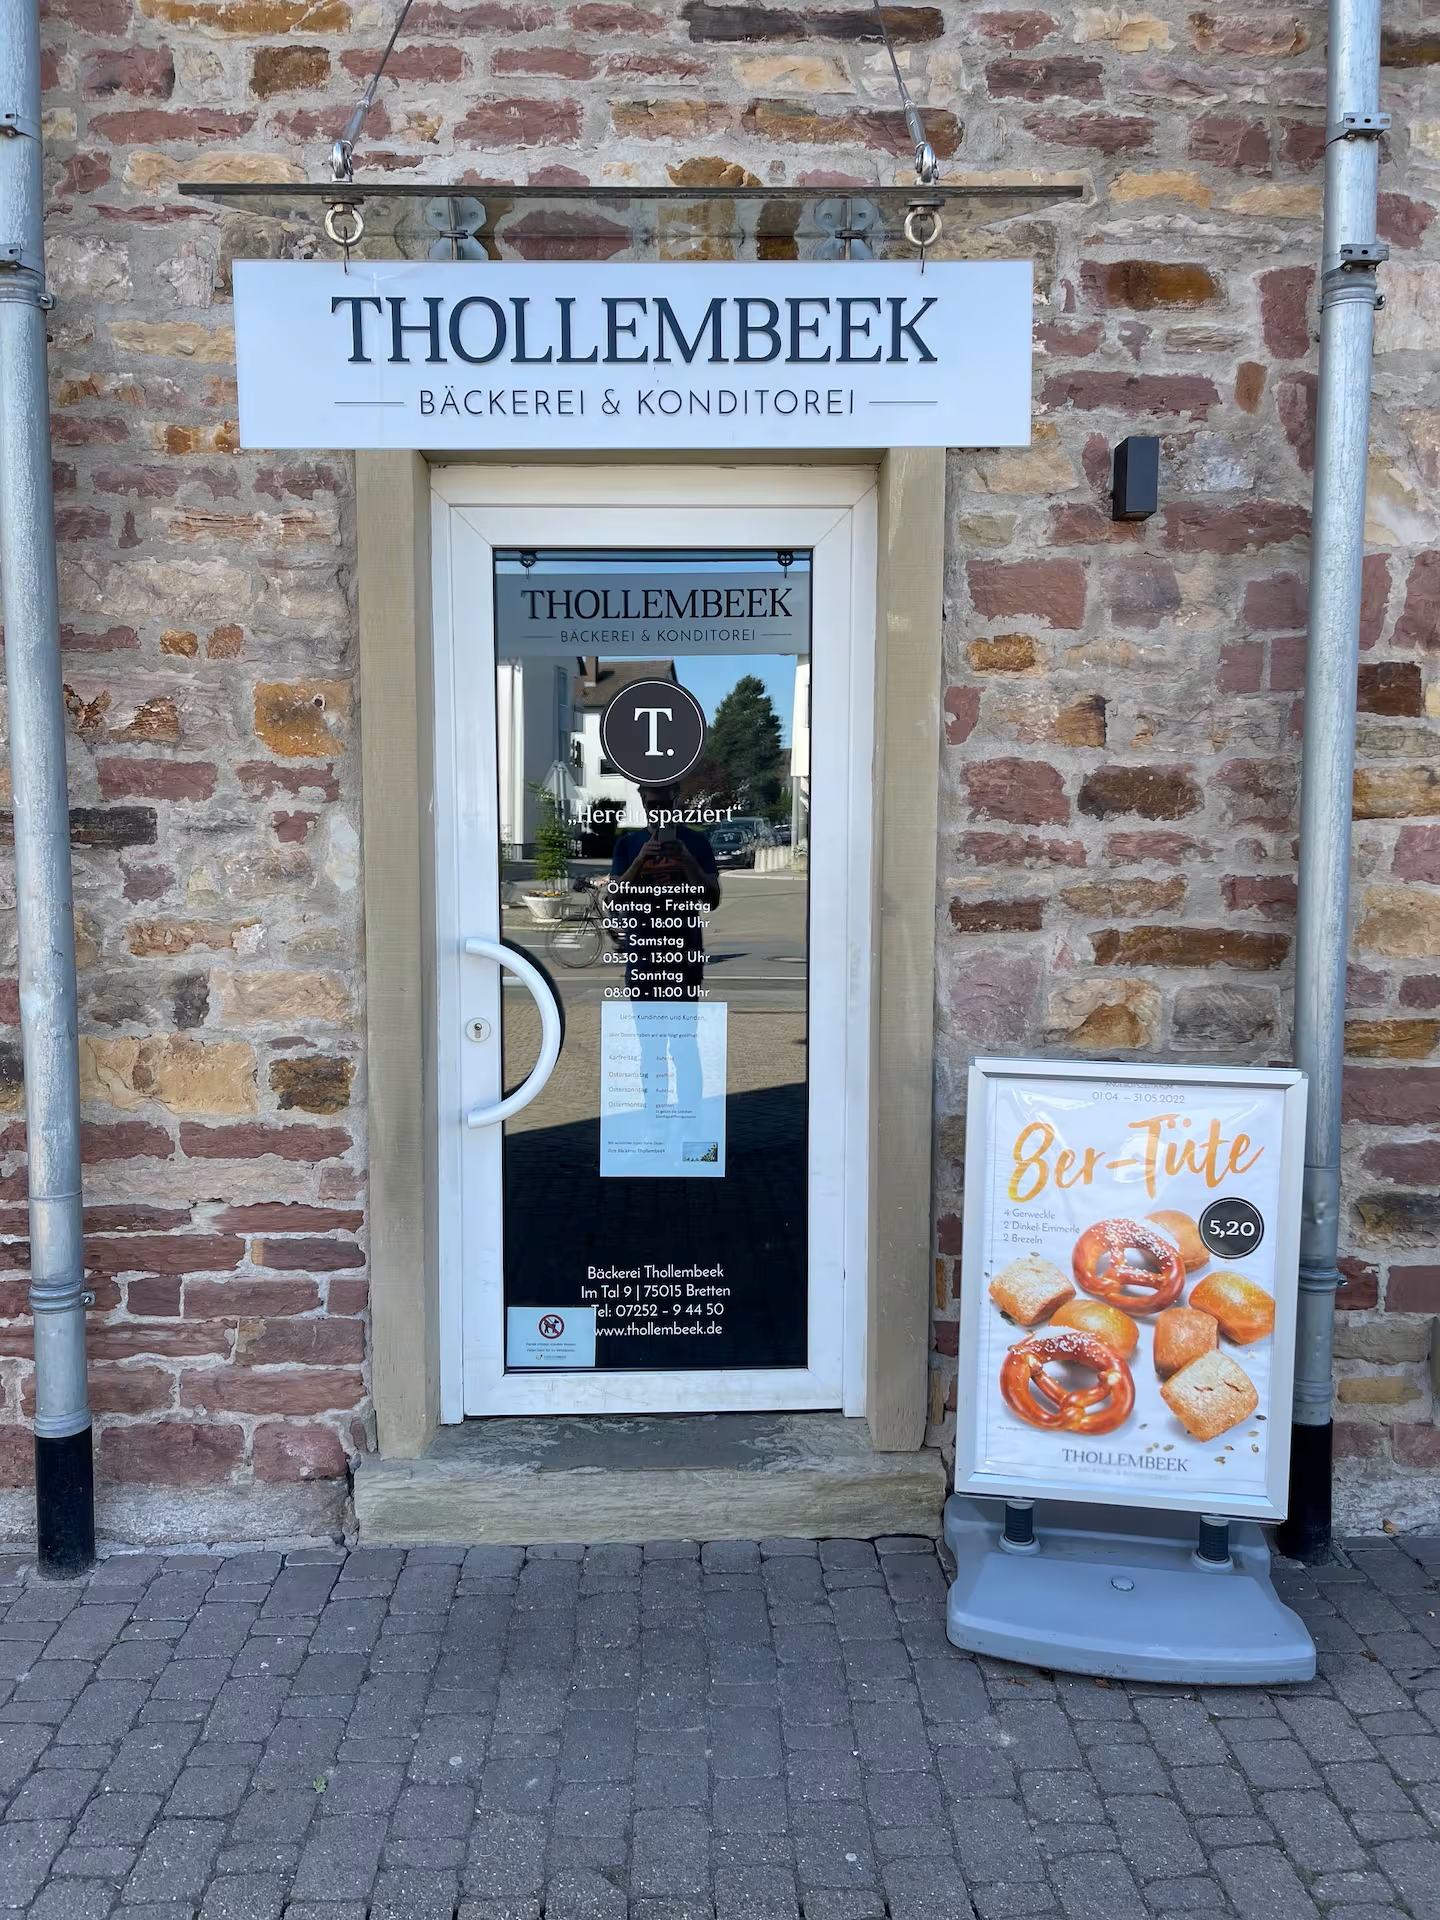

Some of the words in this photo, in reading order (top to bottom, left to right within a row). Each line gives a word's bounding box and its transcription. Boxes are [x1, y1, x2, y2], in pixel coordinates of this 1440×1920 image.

[331, 296, 938, 364] THOLLEMBEEK
[419, 388, 585, 416] BÄCKEREI
[601, 390, 620, 415] &
[638, 389, 855, 416] KONDITOREI
[520, 588, 793, 620] THOLLEMBEEK
[560, 628, 635, 643] BÄCKEREI
[641, 630, 651, 643] &
[657, 628, 756, 642] KONDITOREI
[607, 880, 705, 896] Öffnungszeiten
[602, 900, 652, 913] Montag
[665, 899, 711, 913] Freitag
[602, 918, 638, 929] 05:30
[651, 917, 683, 929] 18:00
[687, 916, 711, 928] Uhr
[629, 934, 685, 948] Samstag
[603, 952, 638, 963] 05:30
[651, 952, 683, 963] 13:00
[687, 951, 711, 963] Uhr
[630, 969, 684, 982] Sonntag
[604, 987, 641, 998] 08:00
[653, 986, 683, 998] 11:00
[687, 985, 710, 997] Uhr
[1007, 1113, 1265, 1203] 8er-Tüte
[1003, 1208, 1010, 1217] 4
[1003, 1220, 1010, 1230] 2
[1208, 1220, 1256, 1239] 5,20
[1003, 1233, 1009, 1242] 2
[1012, 1233, 1043, 1245] Brezeln
[587, 1266, 641, 1279] Bäckerei
[644, 1263, 724, 1279] Thollembeek
[581, 1286, 597, 1299] Im
[601, 1284, 620, 1298] Tal
[624, 1286, 632, 1298] 9
[644, 1285, 682, 1298] 75015
[686, 1284, 730, 1298] Bretten
[591, 1304, 612, 1318] Tel:
[616, 1304, 658, 1317] 07252
[672, 1304, 680, 1316] 9
[685, 1303, 702, 1316] 44
[706, 1303, 724, 1316] 50
[593, 1321, 723, 1337] www.thollembeek.de
[1061, 1448, 1190, 1473] THOLLEMBEEK
